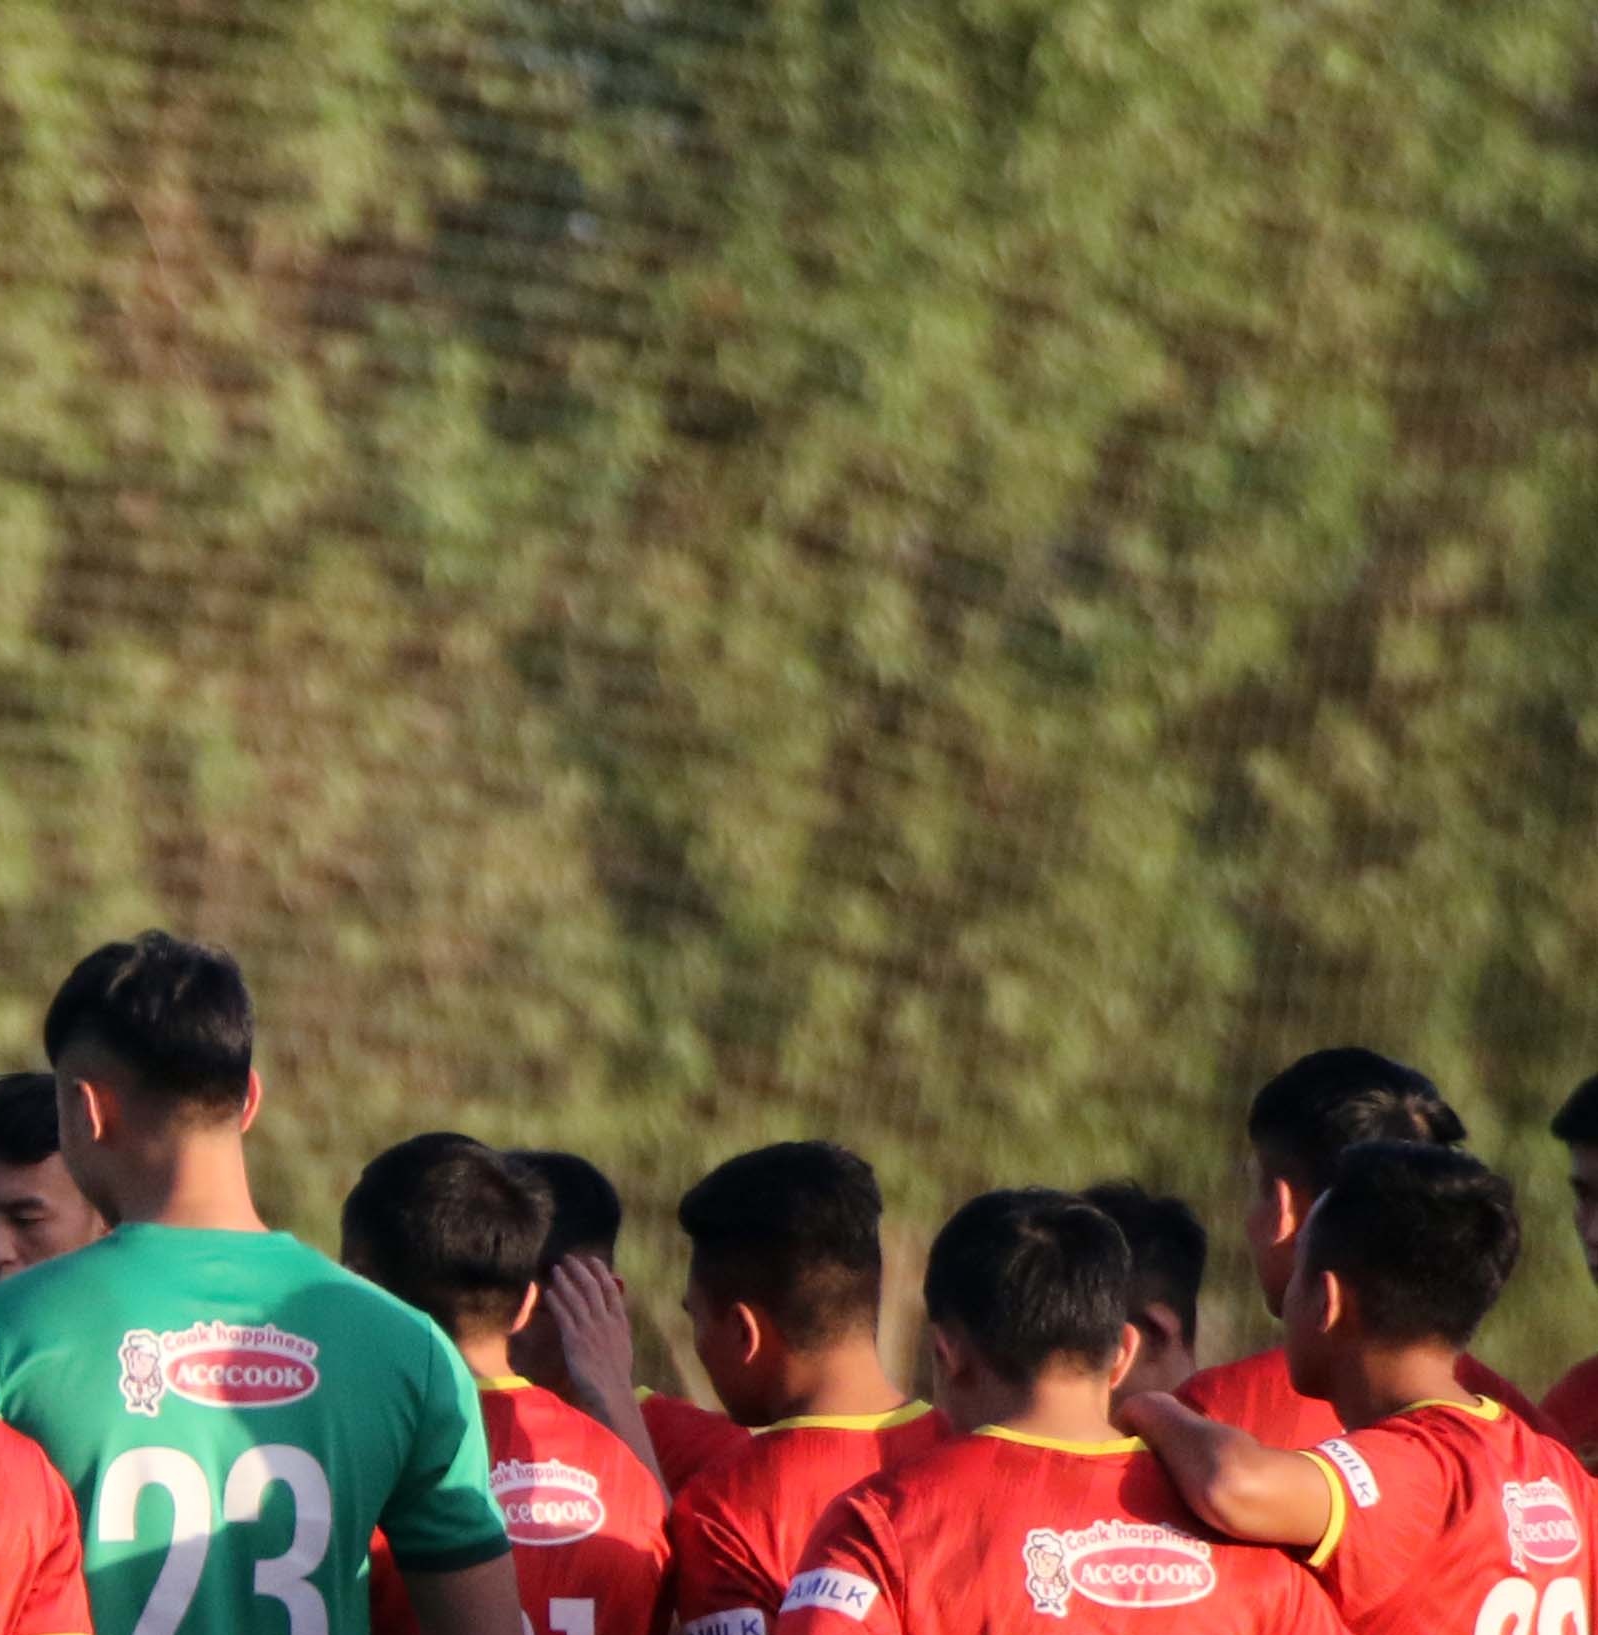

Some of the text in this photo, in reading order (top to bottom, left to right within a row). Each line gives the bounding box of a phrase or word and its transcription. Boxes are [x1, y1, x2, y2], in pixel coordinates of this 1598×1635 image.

[163, 1323, 315, 1357] Cook happiness
[516, 1459, 595, 1489] happiness
[1065, 1525, 1110, 1550] Cook
